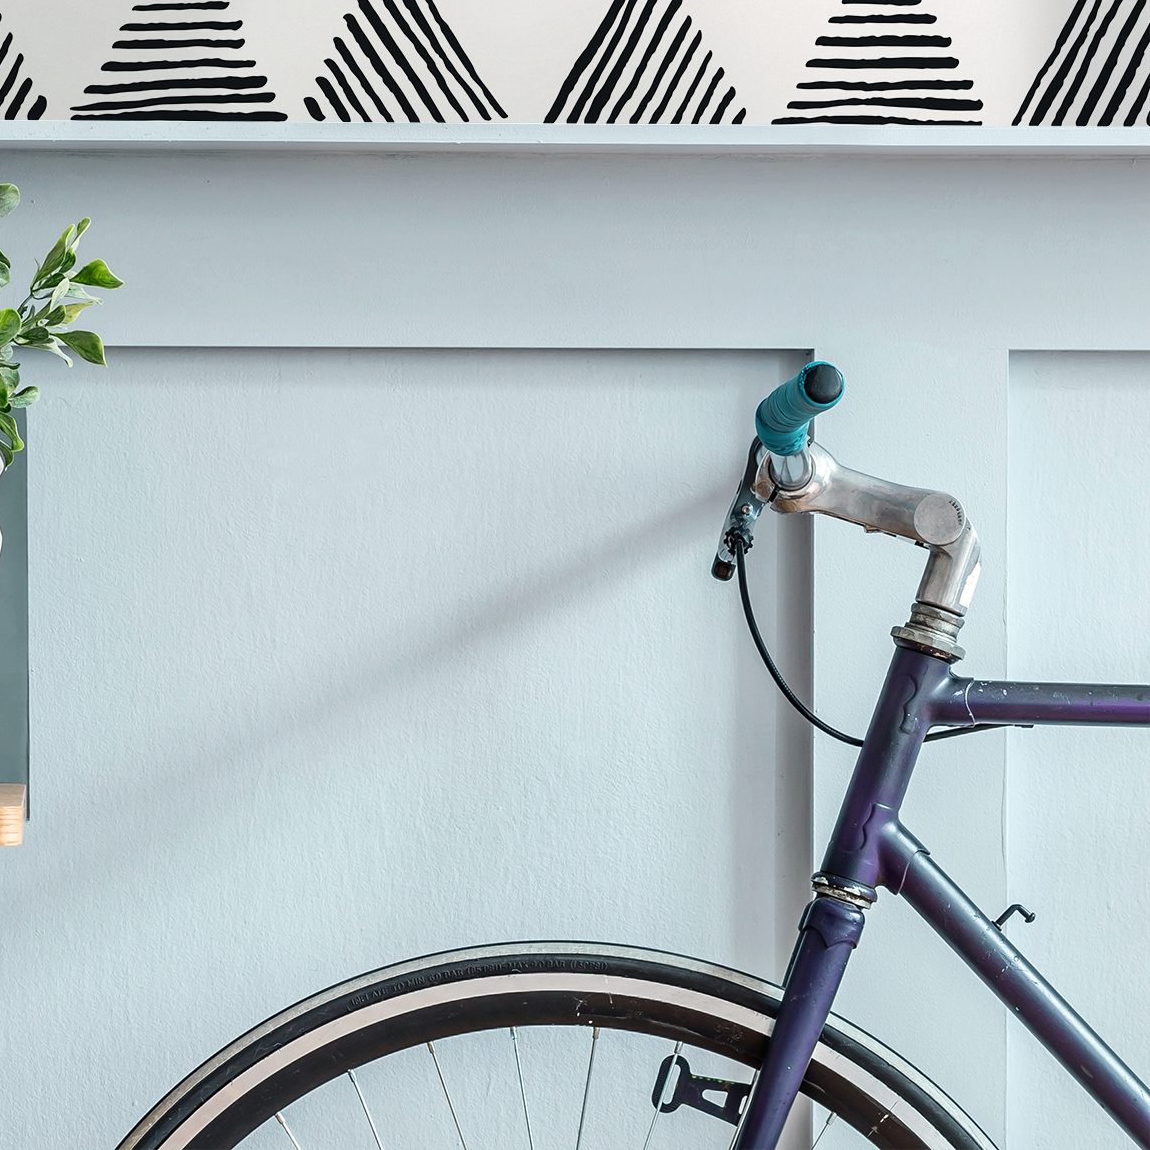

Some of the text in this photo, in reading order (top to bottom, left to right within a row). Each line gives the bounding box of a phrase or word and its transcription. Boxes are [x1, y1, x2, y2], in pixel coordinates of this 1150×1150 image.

[392, 982, 405, 993] TO
[407, 976, 425, 987] MIN
[444, 968, 464, 979] BAR
[548, 960, 566, 969] BAR
